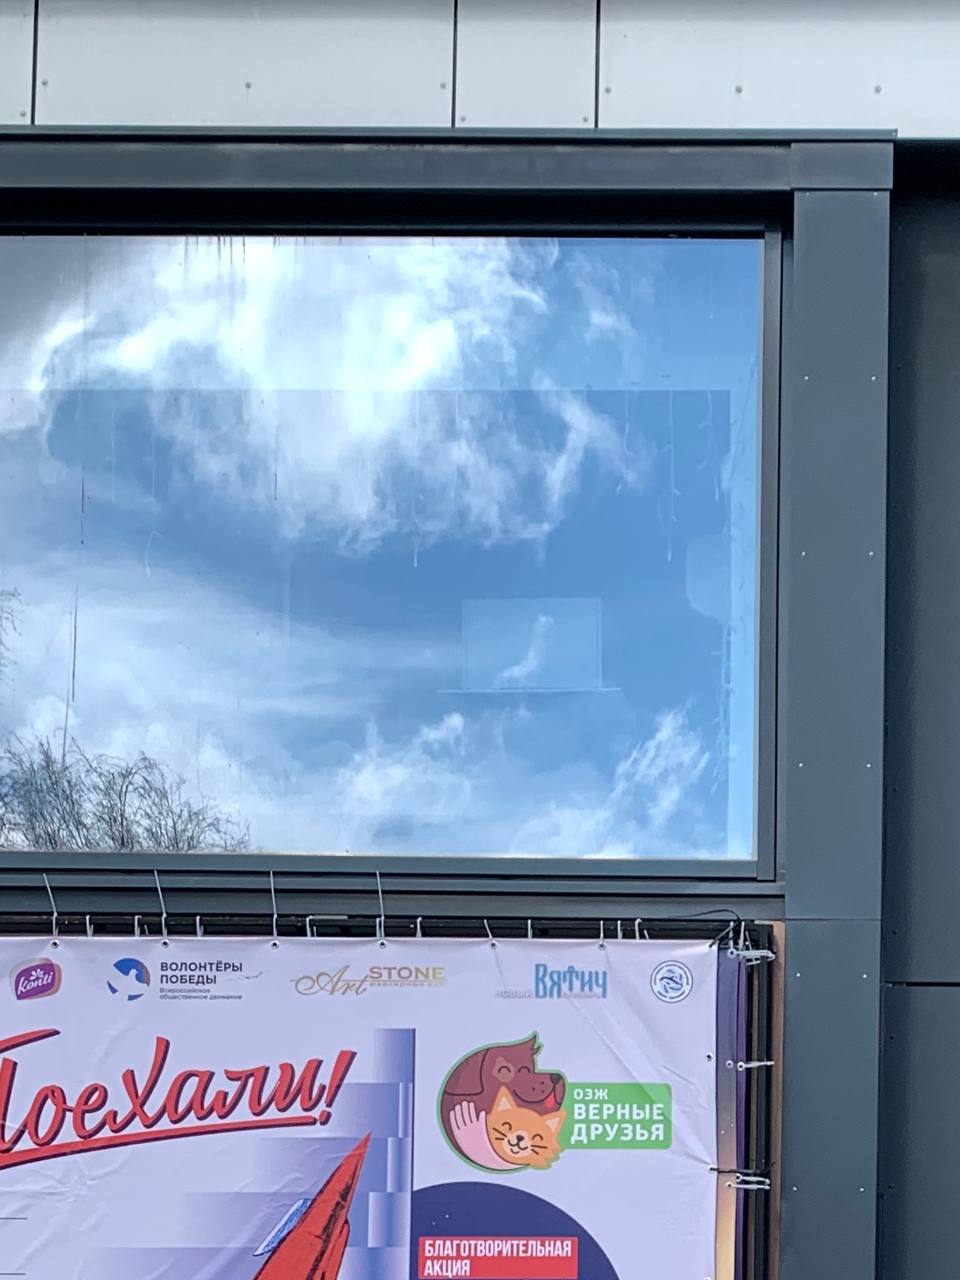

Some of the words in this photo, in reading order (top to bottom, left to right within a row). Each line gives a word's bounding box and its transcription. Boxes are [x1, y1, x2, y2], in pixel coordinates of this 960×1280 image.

[160, 960, 243, 972] ВОЛОНТЁРЫ
[160, 974, 217, 987] ПОБЕДЫ
[290, 964, 369, 996] Art
[369, 966, 446, 980] STONE
[573, 1088, 608, 1100] ОЗЖ
[573, 1104, 665, 1121] ВЕРНЫЕ
[570, 1123, 665, 1144] ДРУЗЬЯ
[424, 1240, 572, 1257] БЛАГОТВОРИТЕЛЬНАЯ
[424, 1260, 471, 1278] АКЦИЯ
